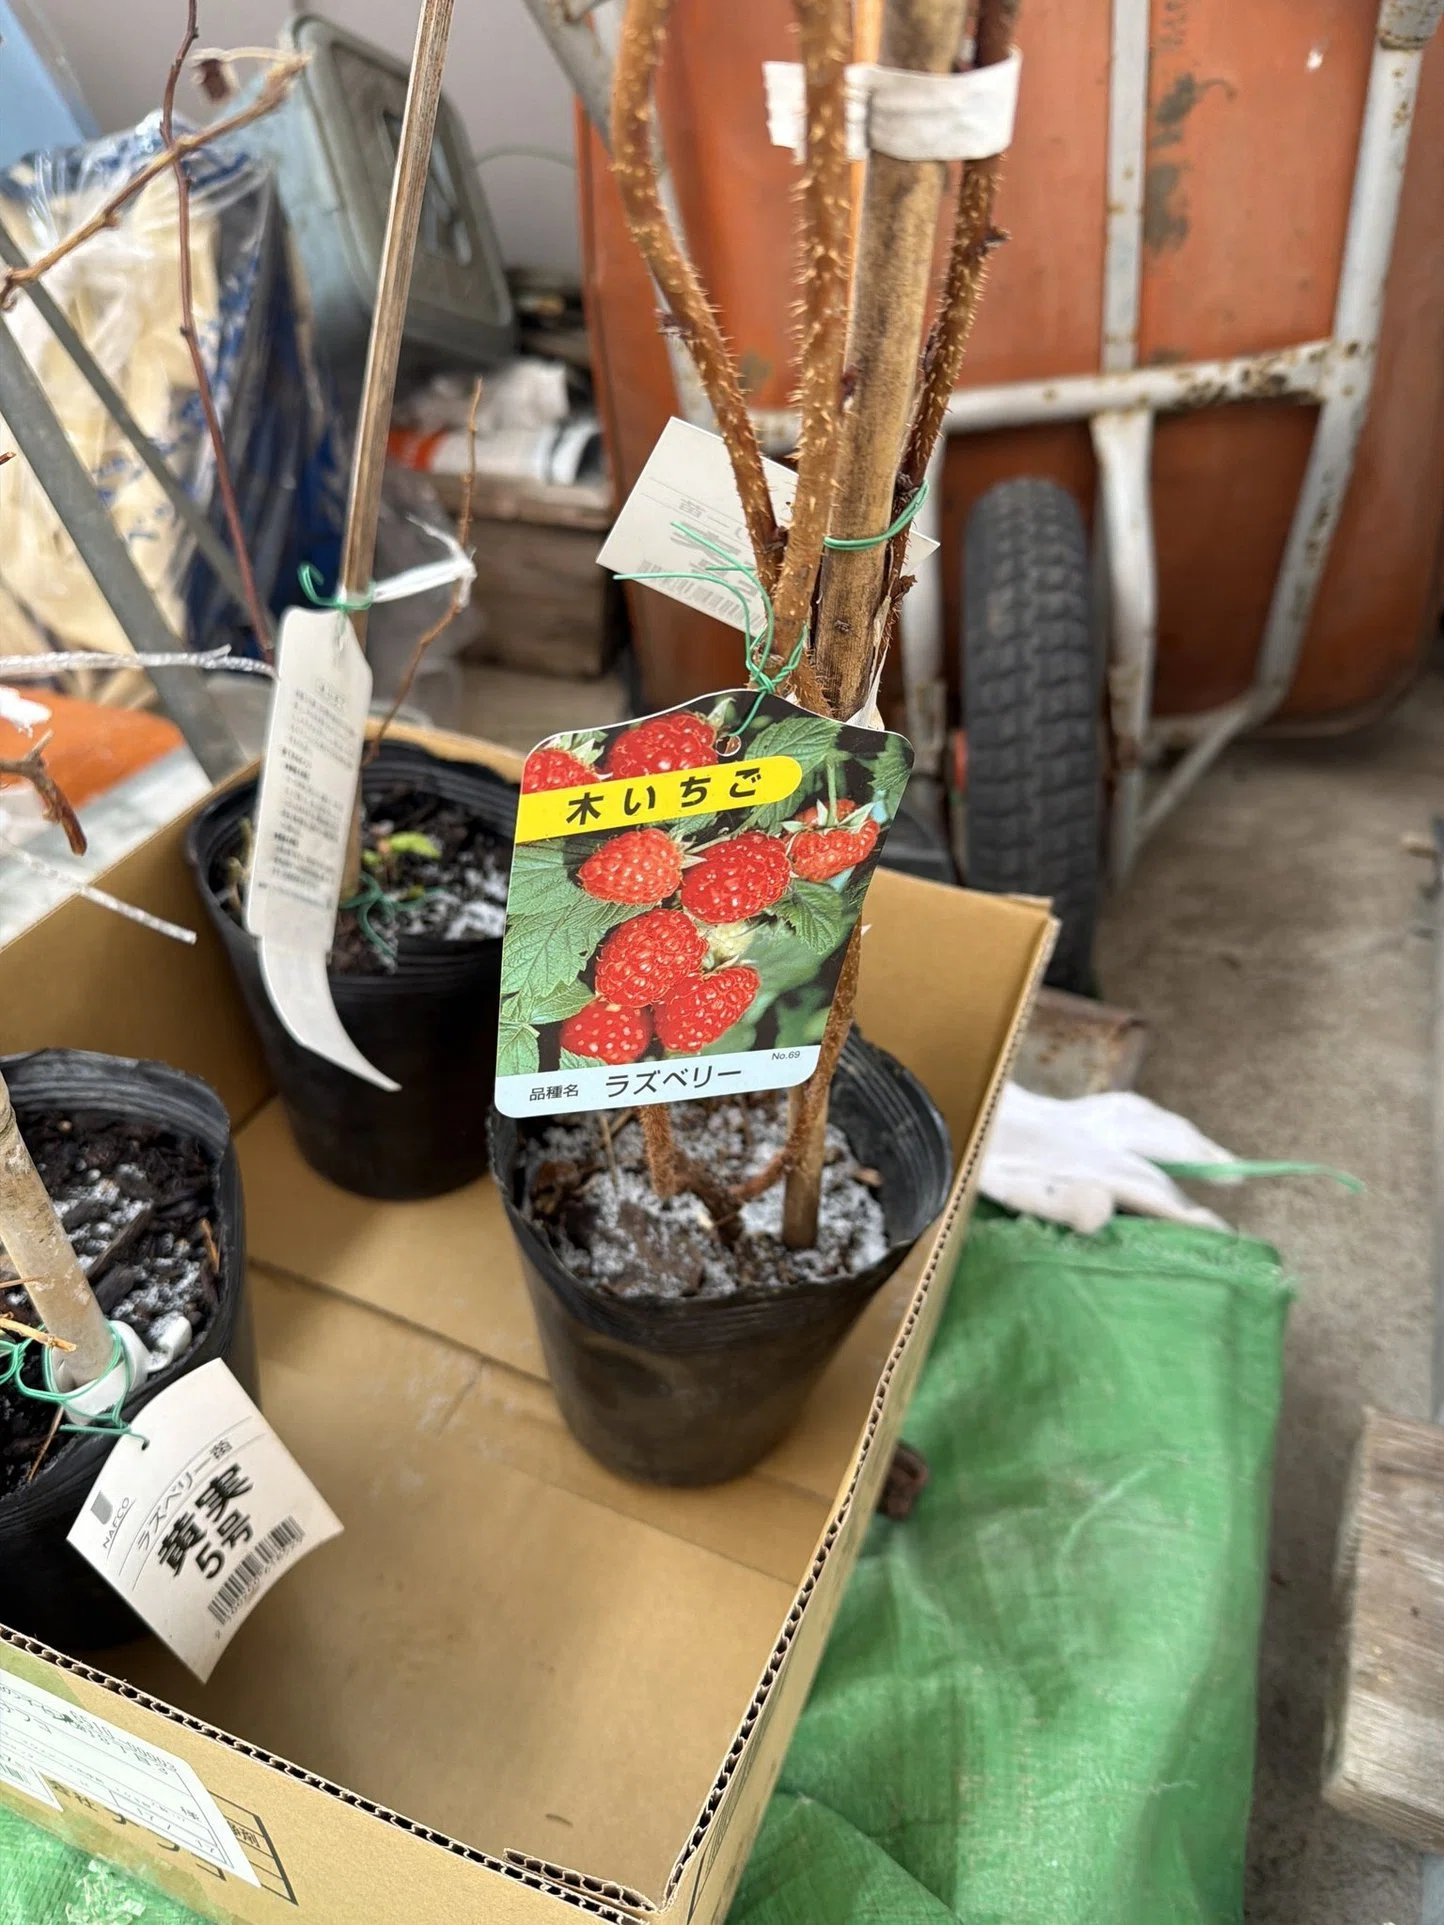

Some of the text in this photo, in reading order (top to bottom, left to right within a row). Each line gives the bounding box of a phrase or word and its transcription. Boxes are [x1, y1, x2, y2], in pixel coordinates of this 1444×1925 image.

[566, 767, 763, 825] 木いちご
[528, 1066, 742, 1102] 品種名 ラズベリー
[771, 1050, 801, 1061] No.69
[102, 1496, 130, 1549] NAFCO
[137, 1438, 233, 1550] ラズベリー苗
[157, 1462, 254, 1577] 黄実
[195, 1508, 254, 1580] 5号
